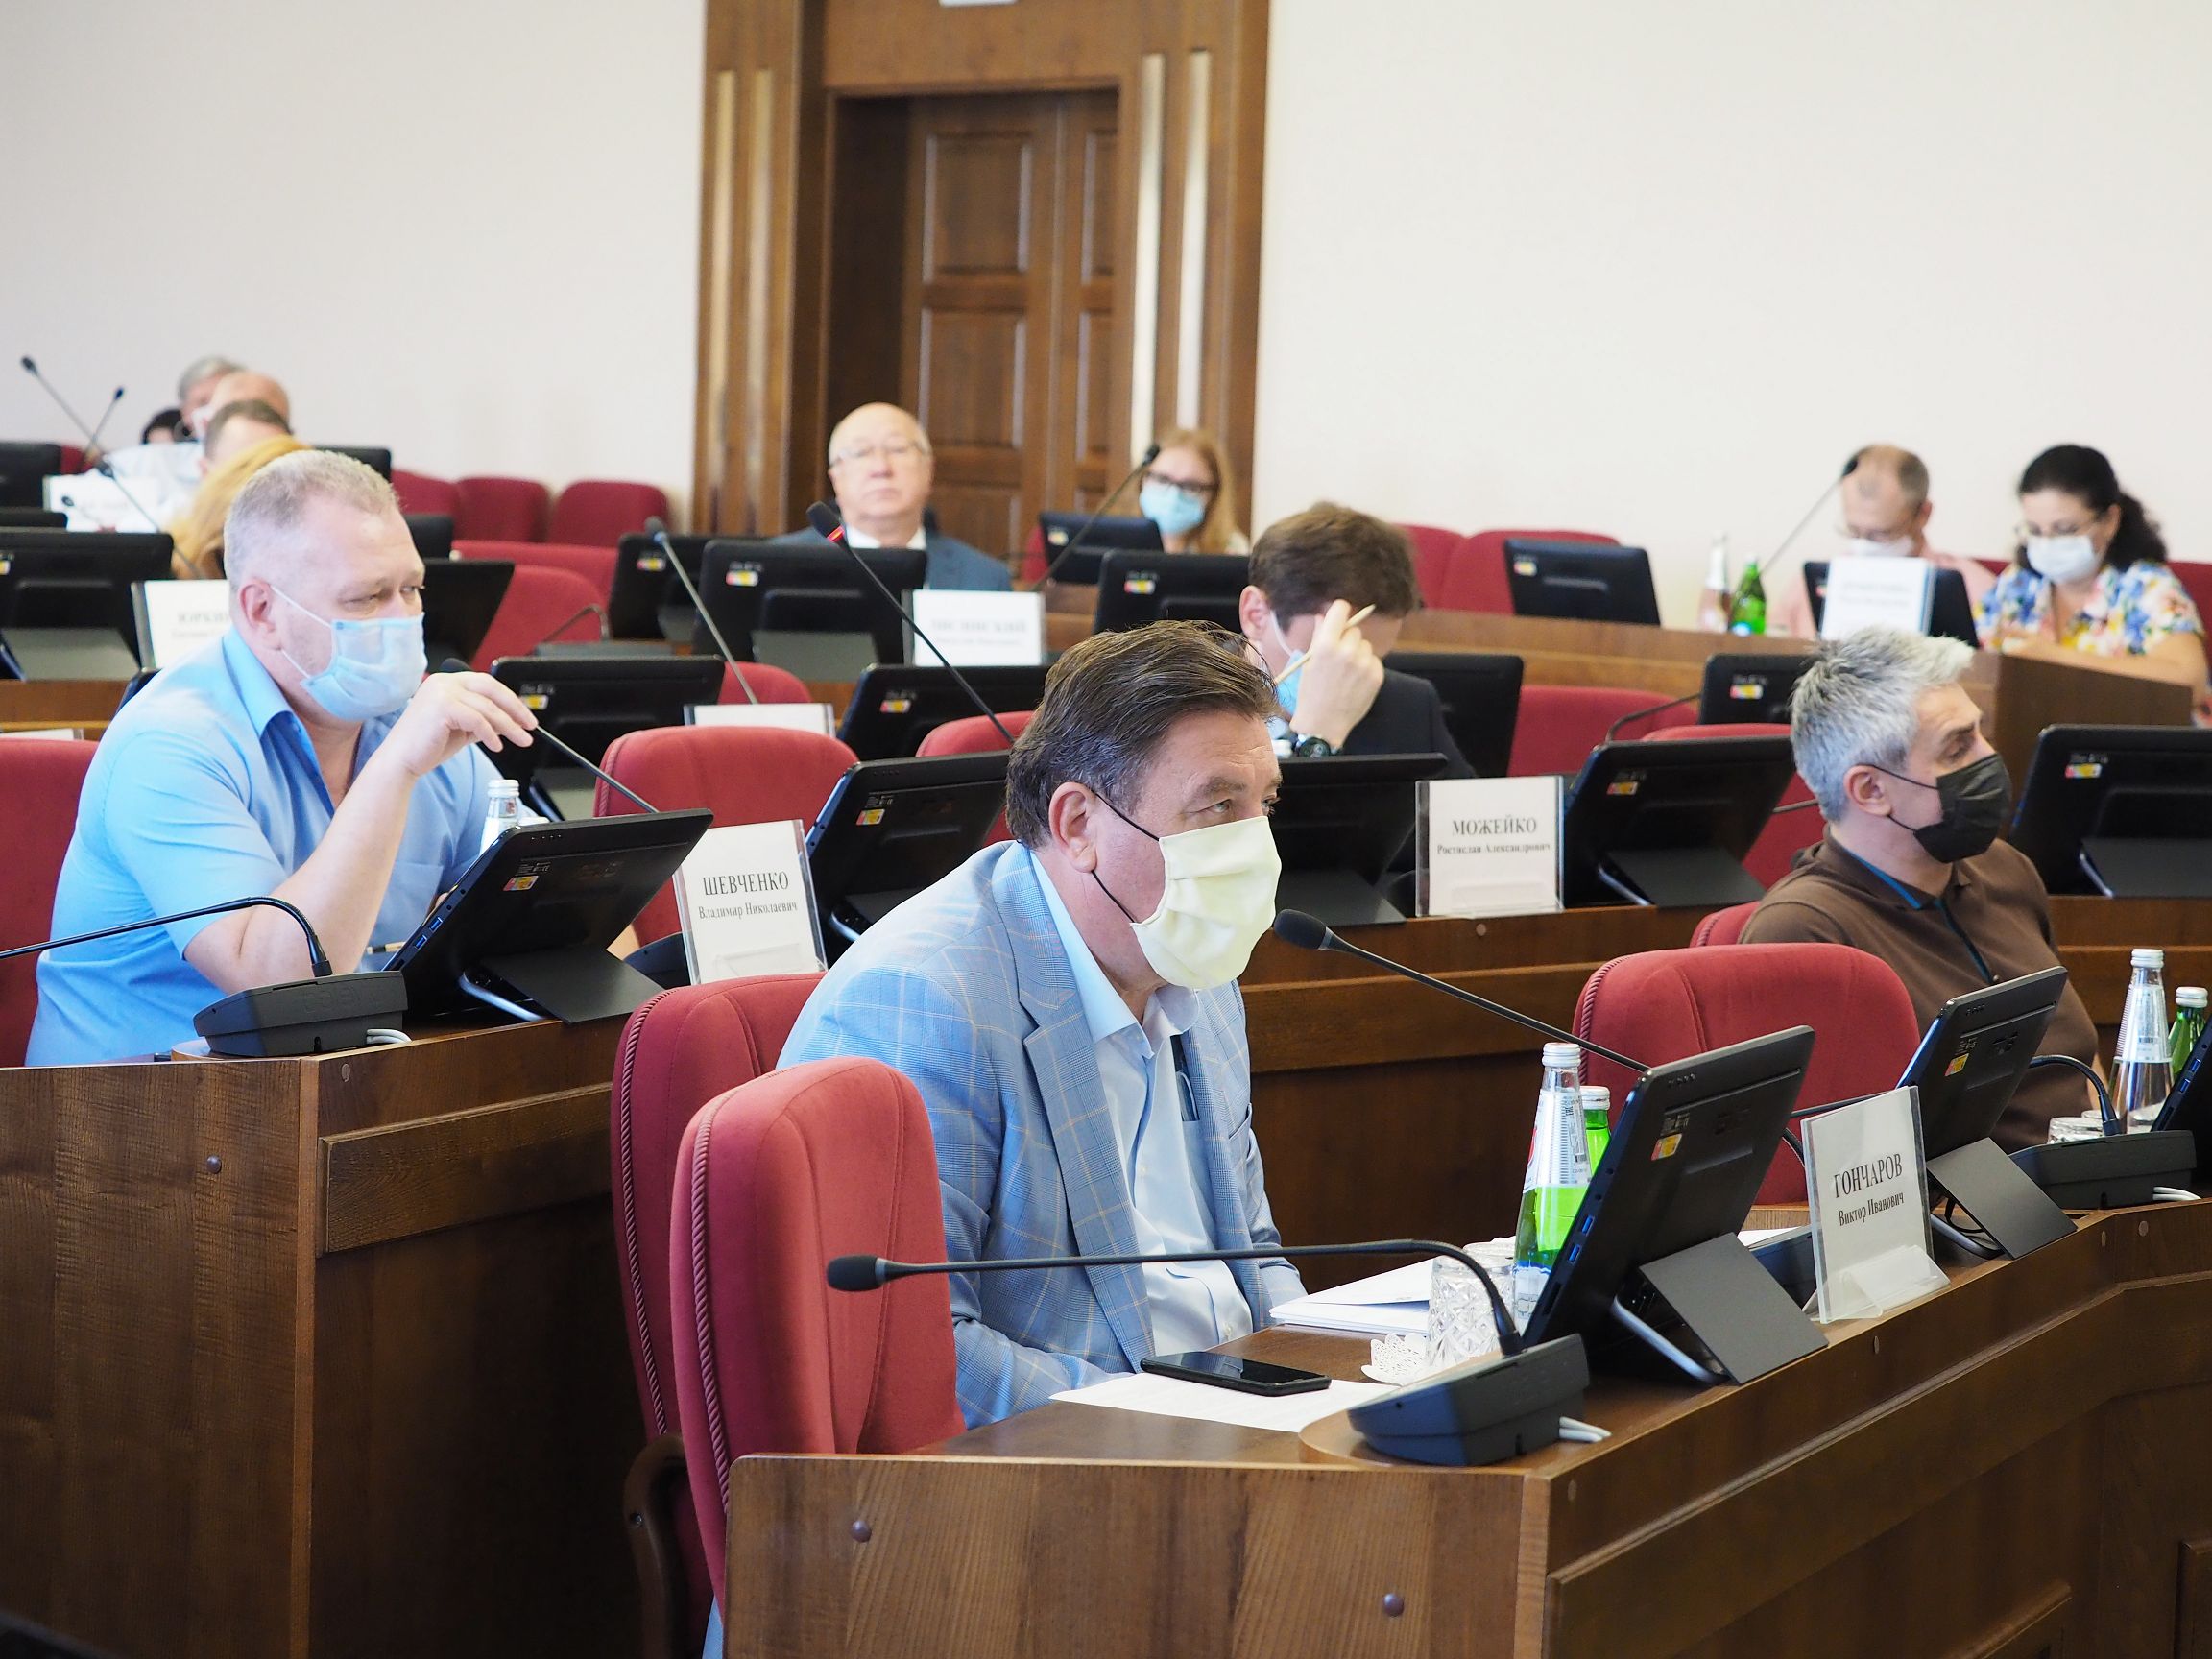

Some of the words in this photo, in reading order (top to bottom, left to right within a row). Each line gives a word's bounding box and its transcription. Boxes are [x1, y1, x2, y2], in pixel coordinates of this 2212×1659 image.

[1453, 815, 1538, 835] МОЖЕЙКО
[703, 871, 789, 895] ШЕВЧЕНКО
[698, 904, 743, 919] Владимир
[745, 902, 798, 916] Николаевич
[1834, 1153, 1903, 1199] ГОНЧАРОВ
[1839, 1206, 1866, 1226] Виктор
[1867, 1192, 1904, 1215] Иванович
